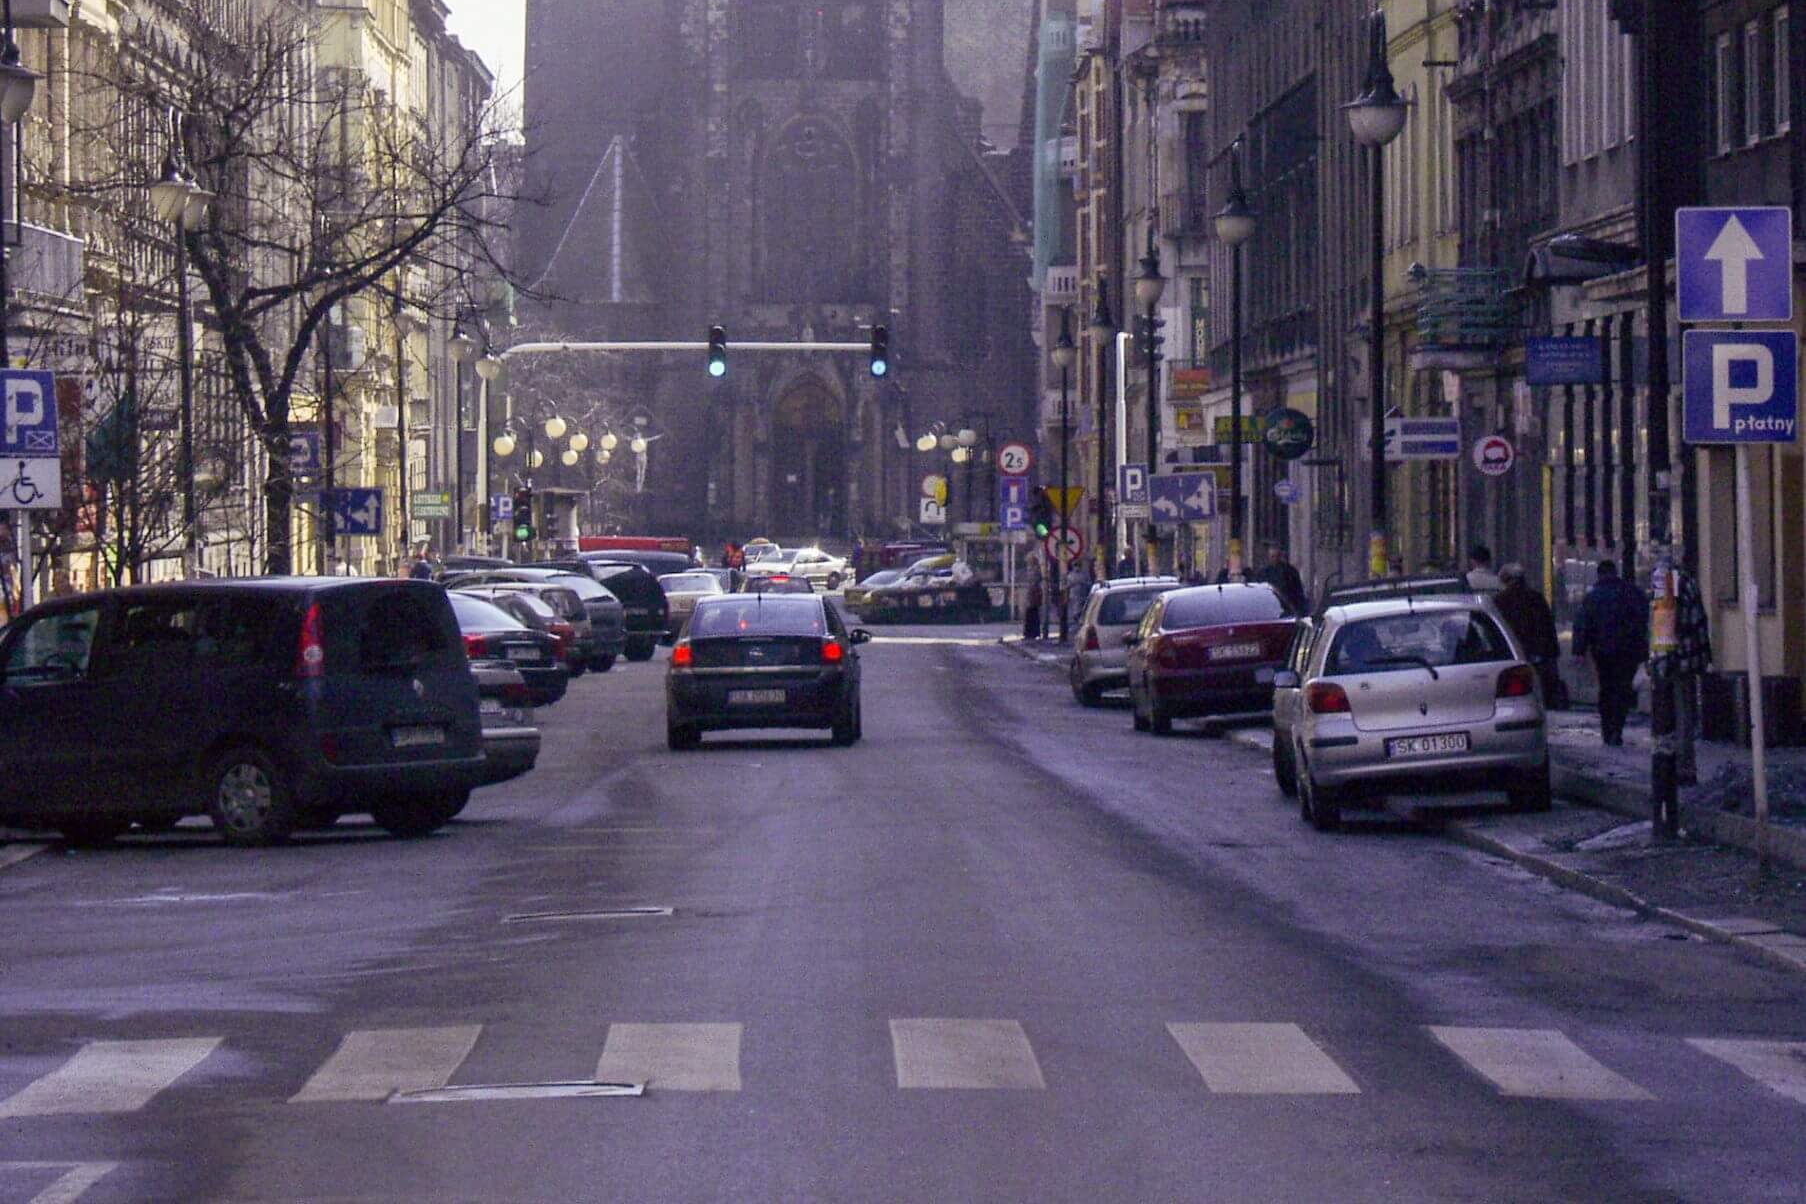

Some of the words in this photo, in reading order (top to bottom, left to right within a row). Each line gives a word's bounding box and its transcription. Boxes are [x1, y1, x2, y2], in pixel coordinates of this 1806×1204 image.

[1712, 343, 1774, 429] P
[5, 379, 43, 444] P
[1735, 414, 1794, 435] płatny
[1125, 468, 1142, 500] P
[1006, 507, 1022, 528] P
[1397, 738, 1417, 754] SK
[1421, 735, 1465, 751] 01300
